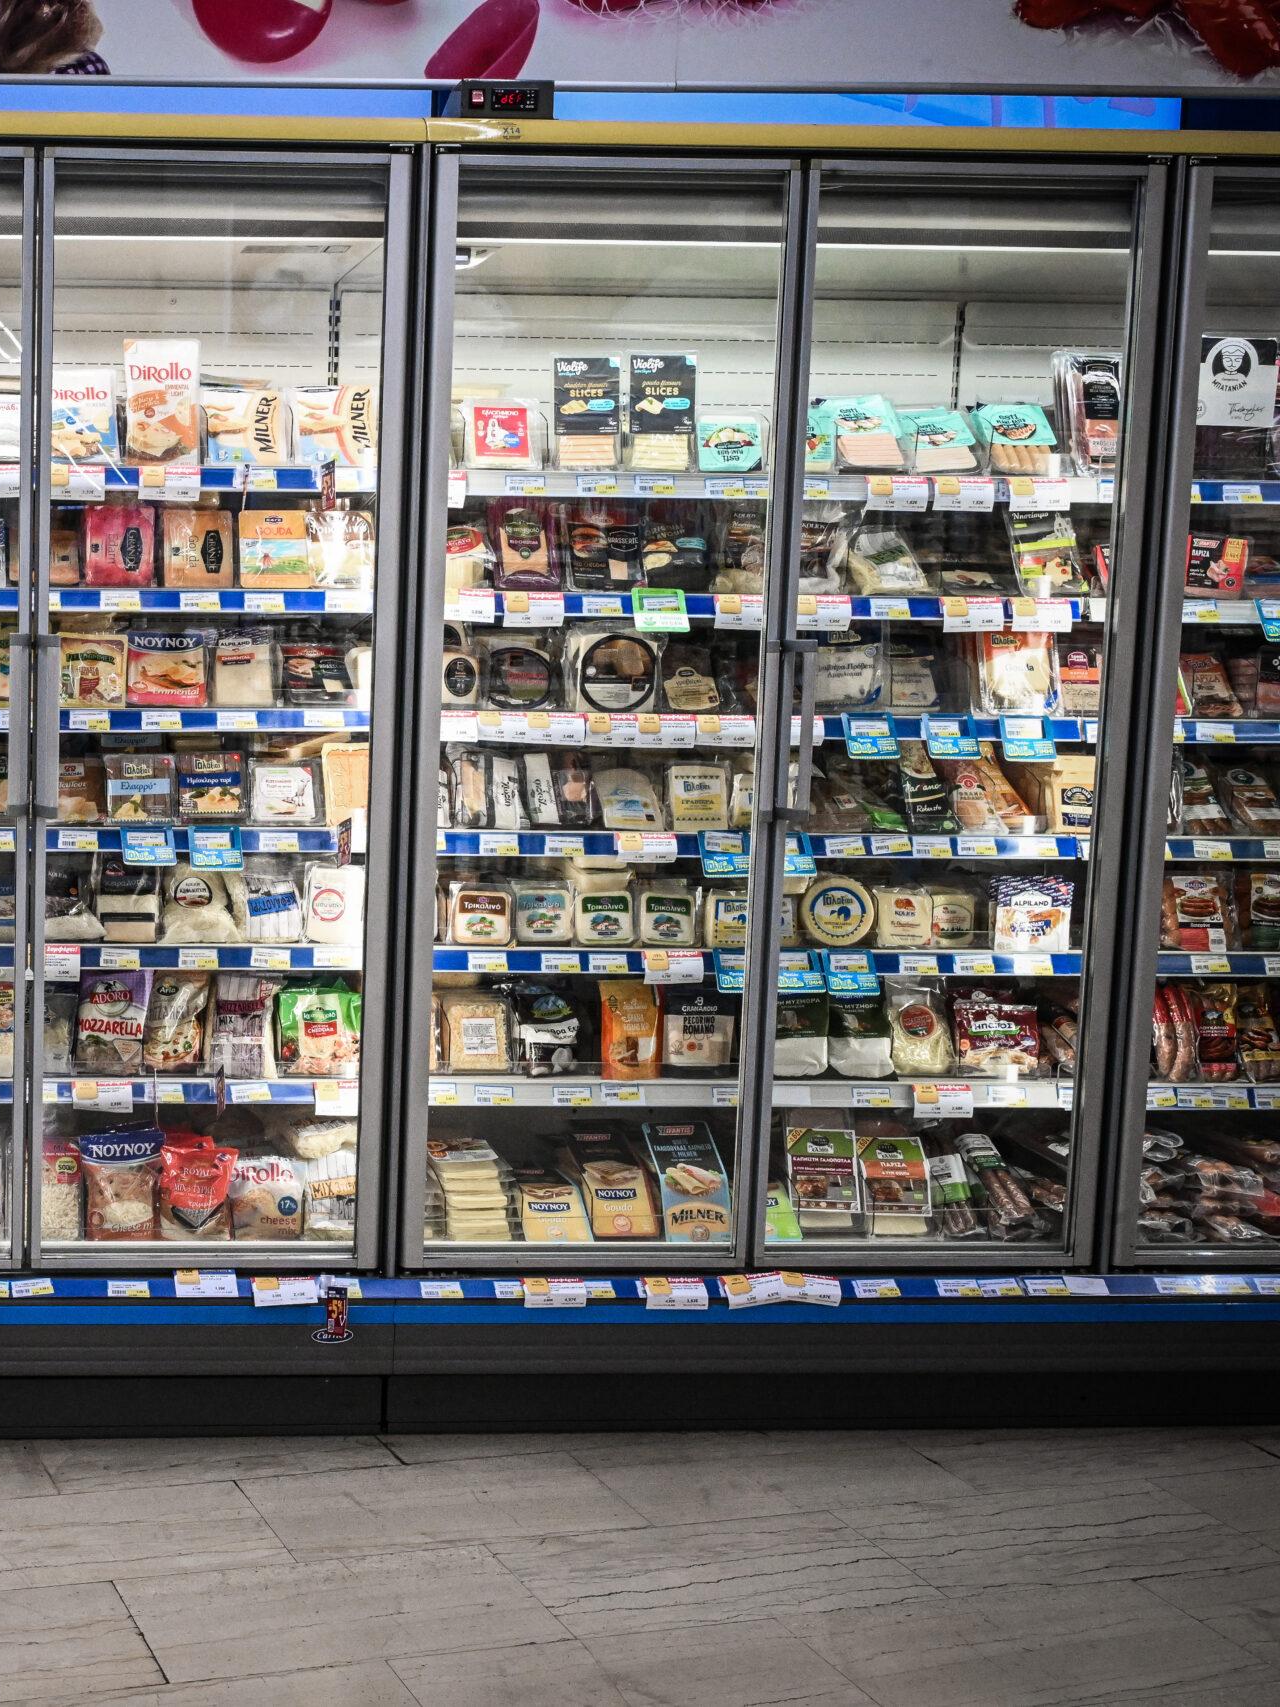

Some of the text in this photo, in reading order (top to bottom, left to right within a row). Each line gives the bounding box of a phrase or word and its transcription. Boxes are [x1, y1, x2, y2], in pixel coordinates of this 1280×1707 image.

[557, 361, 588, 376] Violife
[633, 359, 664, 373] Violife
[129, 363, 192, 382] DiRollo
[1211, 379, 1248, 392] ΜΠΑΤΑΝΙΑΝ
[570, 389, 603, 398] SLICES
[645, 387, 679, 396] SLICES
[252, 396, 277, 454] MILNER
[1011, 511, 1049, 520] Νηστίσιμο
[207, 532, 218, 572] GRANDE
[134, 636, 197, 648] NOYNOY
[220, 639, 251, 647] ALPILAND
[151, 688, 199, 697] Emmental
[464, 900, 501, 910] Τρικαλινό
[587, 902, 624, 911] Τρικαλινό
[650, 903, 686, 912] Τρικαλινό
[45, 945, 79, 953] Συμφέρει!
[92, 993, 129, 1003] ADORO
[219, 1016, 234, 1025] MIX
[683, 1016, 715, 1025] PECORINO
[79, 1018, 143, 1037] MOZZARELLA
[683, 1024, 715, 1035] ROMANO
[90, 1143, 156, 1159] NOYNOY
[183, 1167, 212, 1177] ROYAL
[312, 1182, 332, 1198] MIX
[597, 1189, 635, 1198] NOYNOY
[280, 1200, 297, 1209] 17%
[531, 1203, 569, 1211] NOYNOY
[604, 1202, 633, 1212] Gouda
[261, 1217, 297, 1225] cheese
[671, 1208, 725, 1225] MILNER
[278, 1227, 297, 1235] mix
